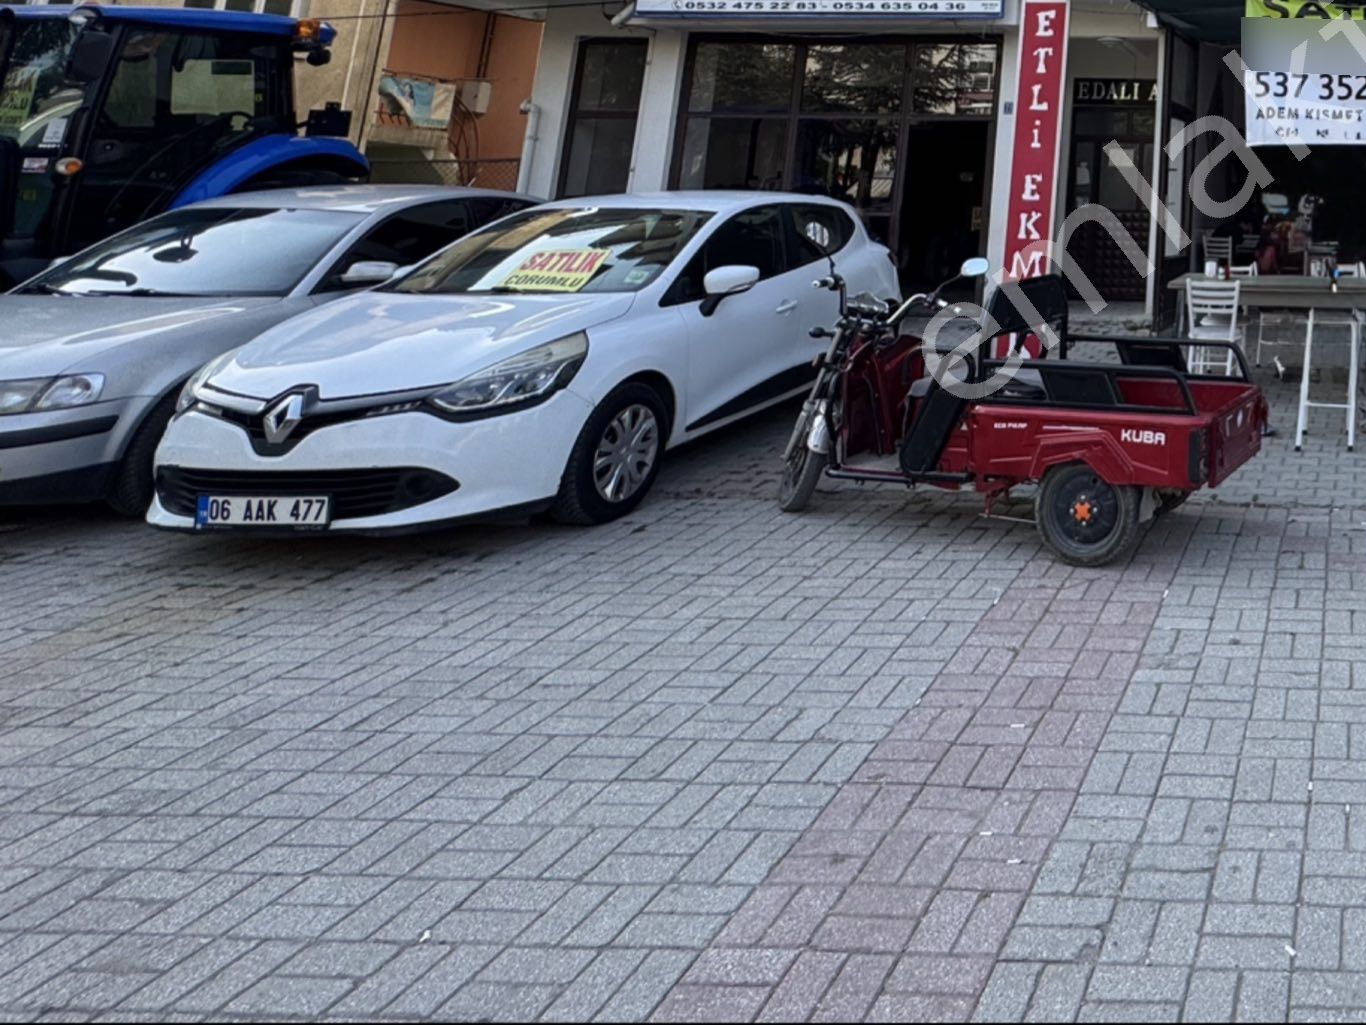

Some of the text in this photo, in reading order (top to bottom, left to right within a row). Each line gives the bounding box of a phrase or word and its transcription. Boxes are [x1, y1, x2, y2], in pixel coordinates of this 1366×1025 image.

[685, 1, 727, 10] 0532
[732, 1, 764, 10] 475
[769, 1, 791, 10] 22
[796, 1, 817, 10] 83
[832, 1, 876, 11] 0534
[880, 2, 913, 11] 635
[918, 2, 939, 11] 04
[944, 2, 966, 11] 36
[1078, 81, 1140, 100] EDALI
[1254, 71, 1309, 98] 537
[1256, 106, 1299, 120] ADEM
[520, 251, 606, 273] SATILIK
[1121, 429, 1166, 445] KUBA
[209, 499, 326, 521] 06 AAK 477
